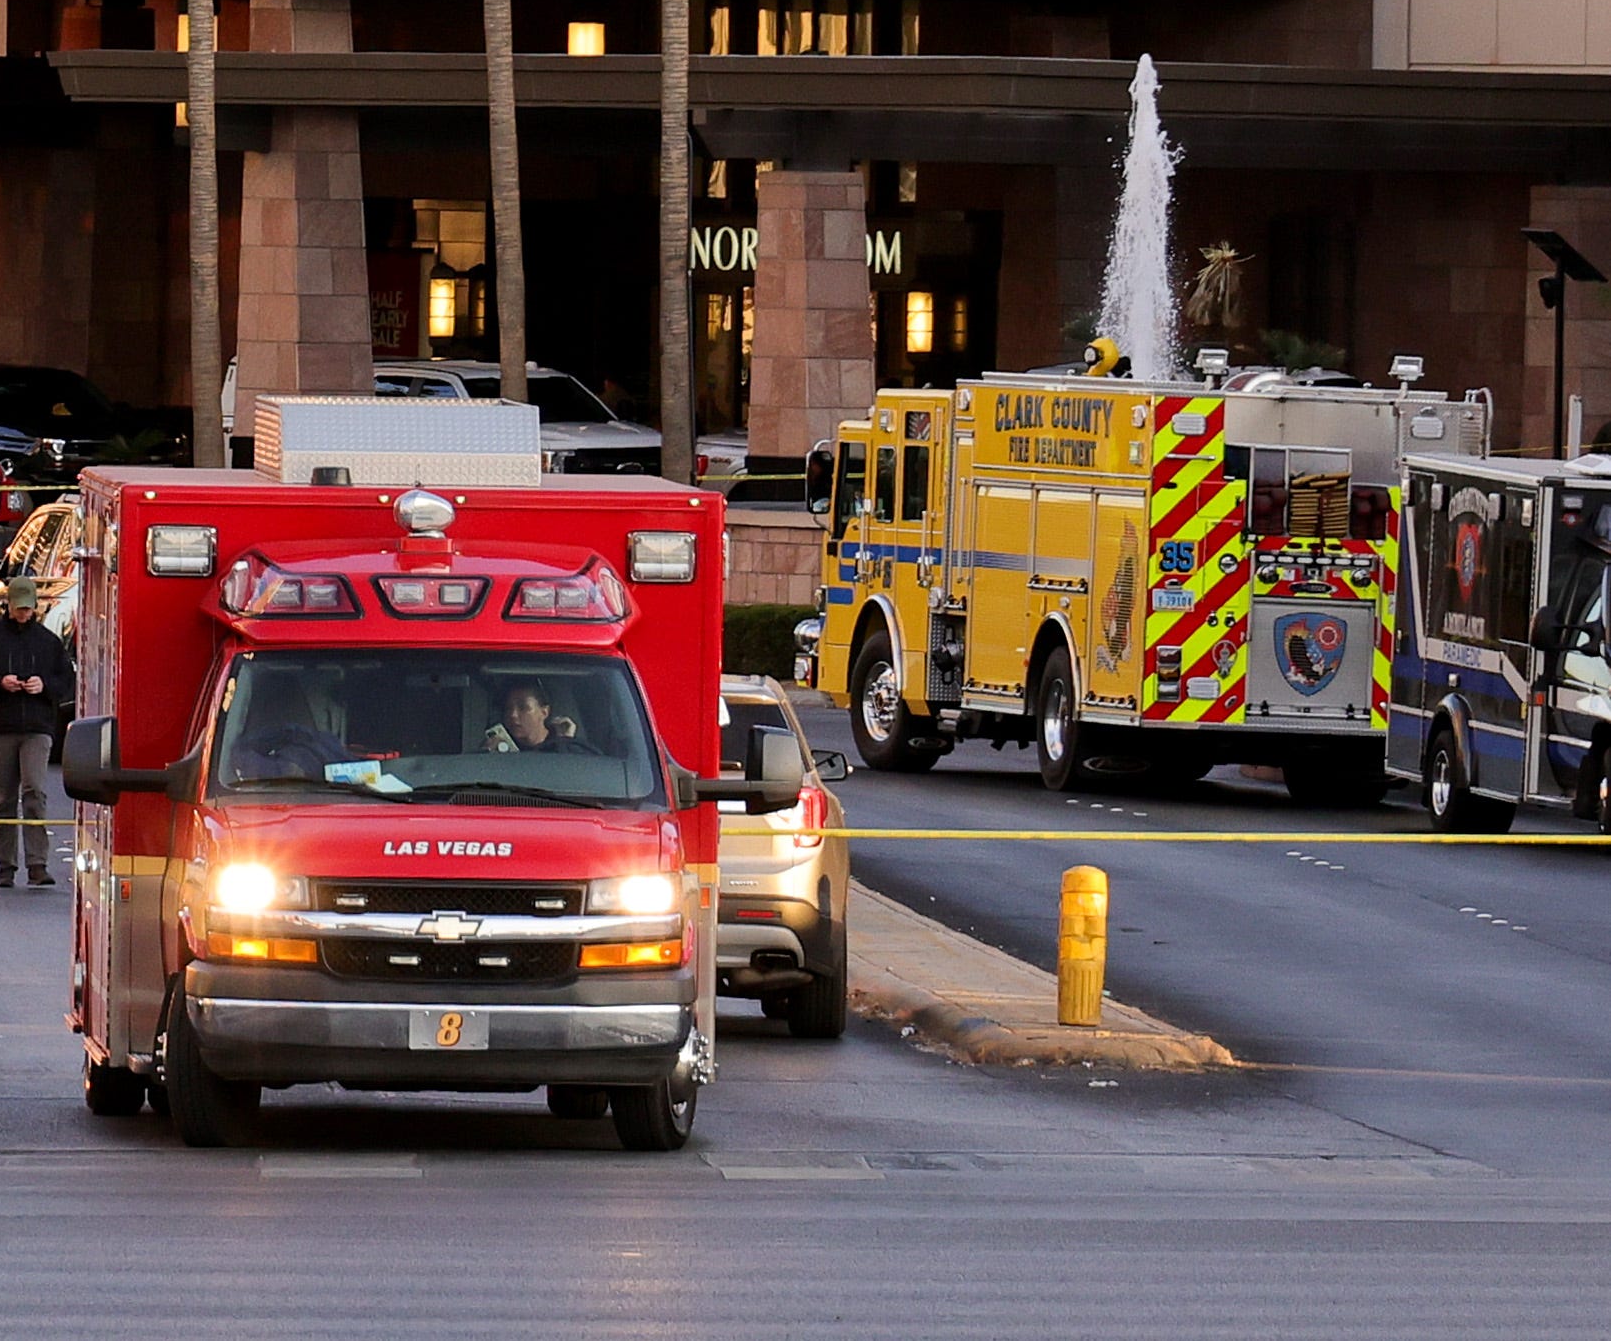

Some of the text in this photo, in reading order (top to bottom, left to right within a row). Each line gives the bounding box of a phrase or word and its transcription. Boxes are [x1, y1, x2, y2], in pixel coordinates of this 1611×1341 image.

[995, 393, 1114, 438] CLARK COUNTY
[1008, 436, 1097, 468] FIRE DEPARTMENT
[1159, 540, 1195, 573] 35
[384, 840, 513, 857] LAS VEGAS
[435, 1011, 463, 1047] 8
